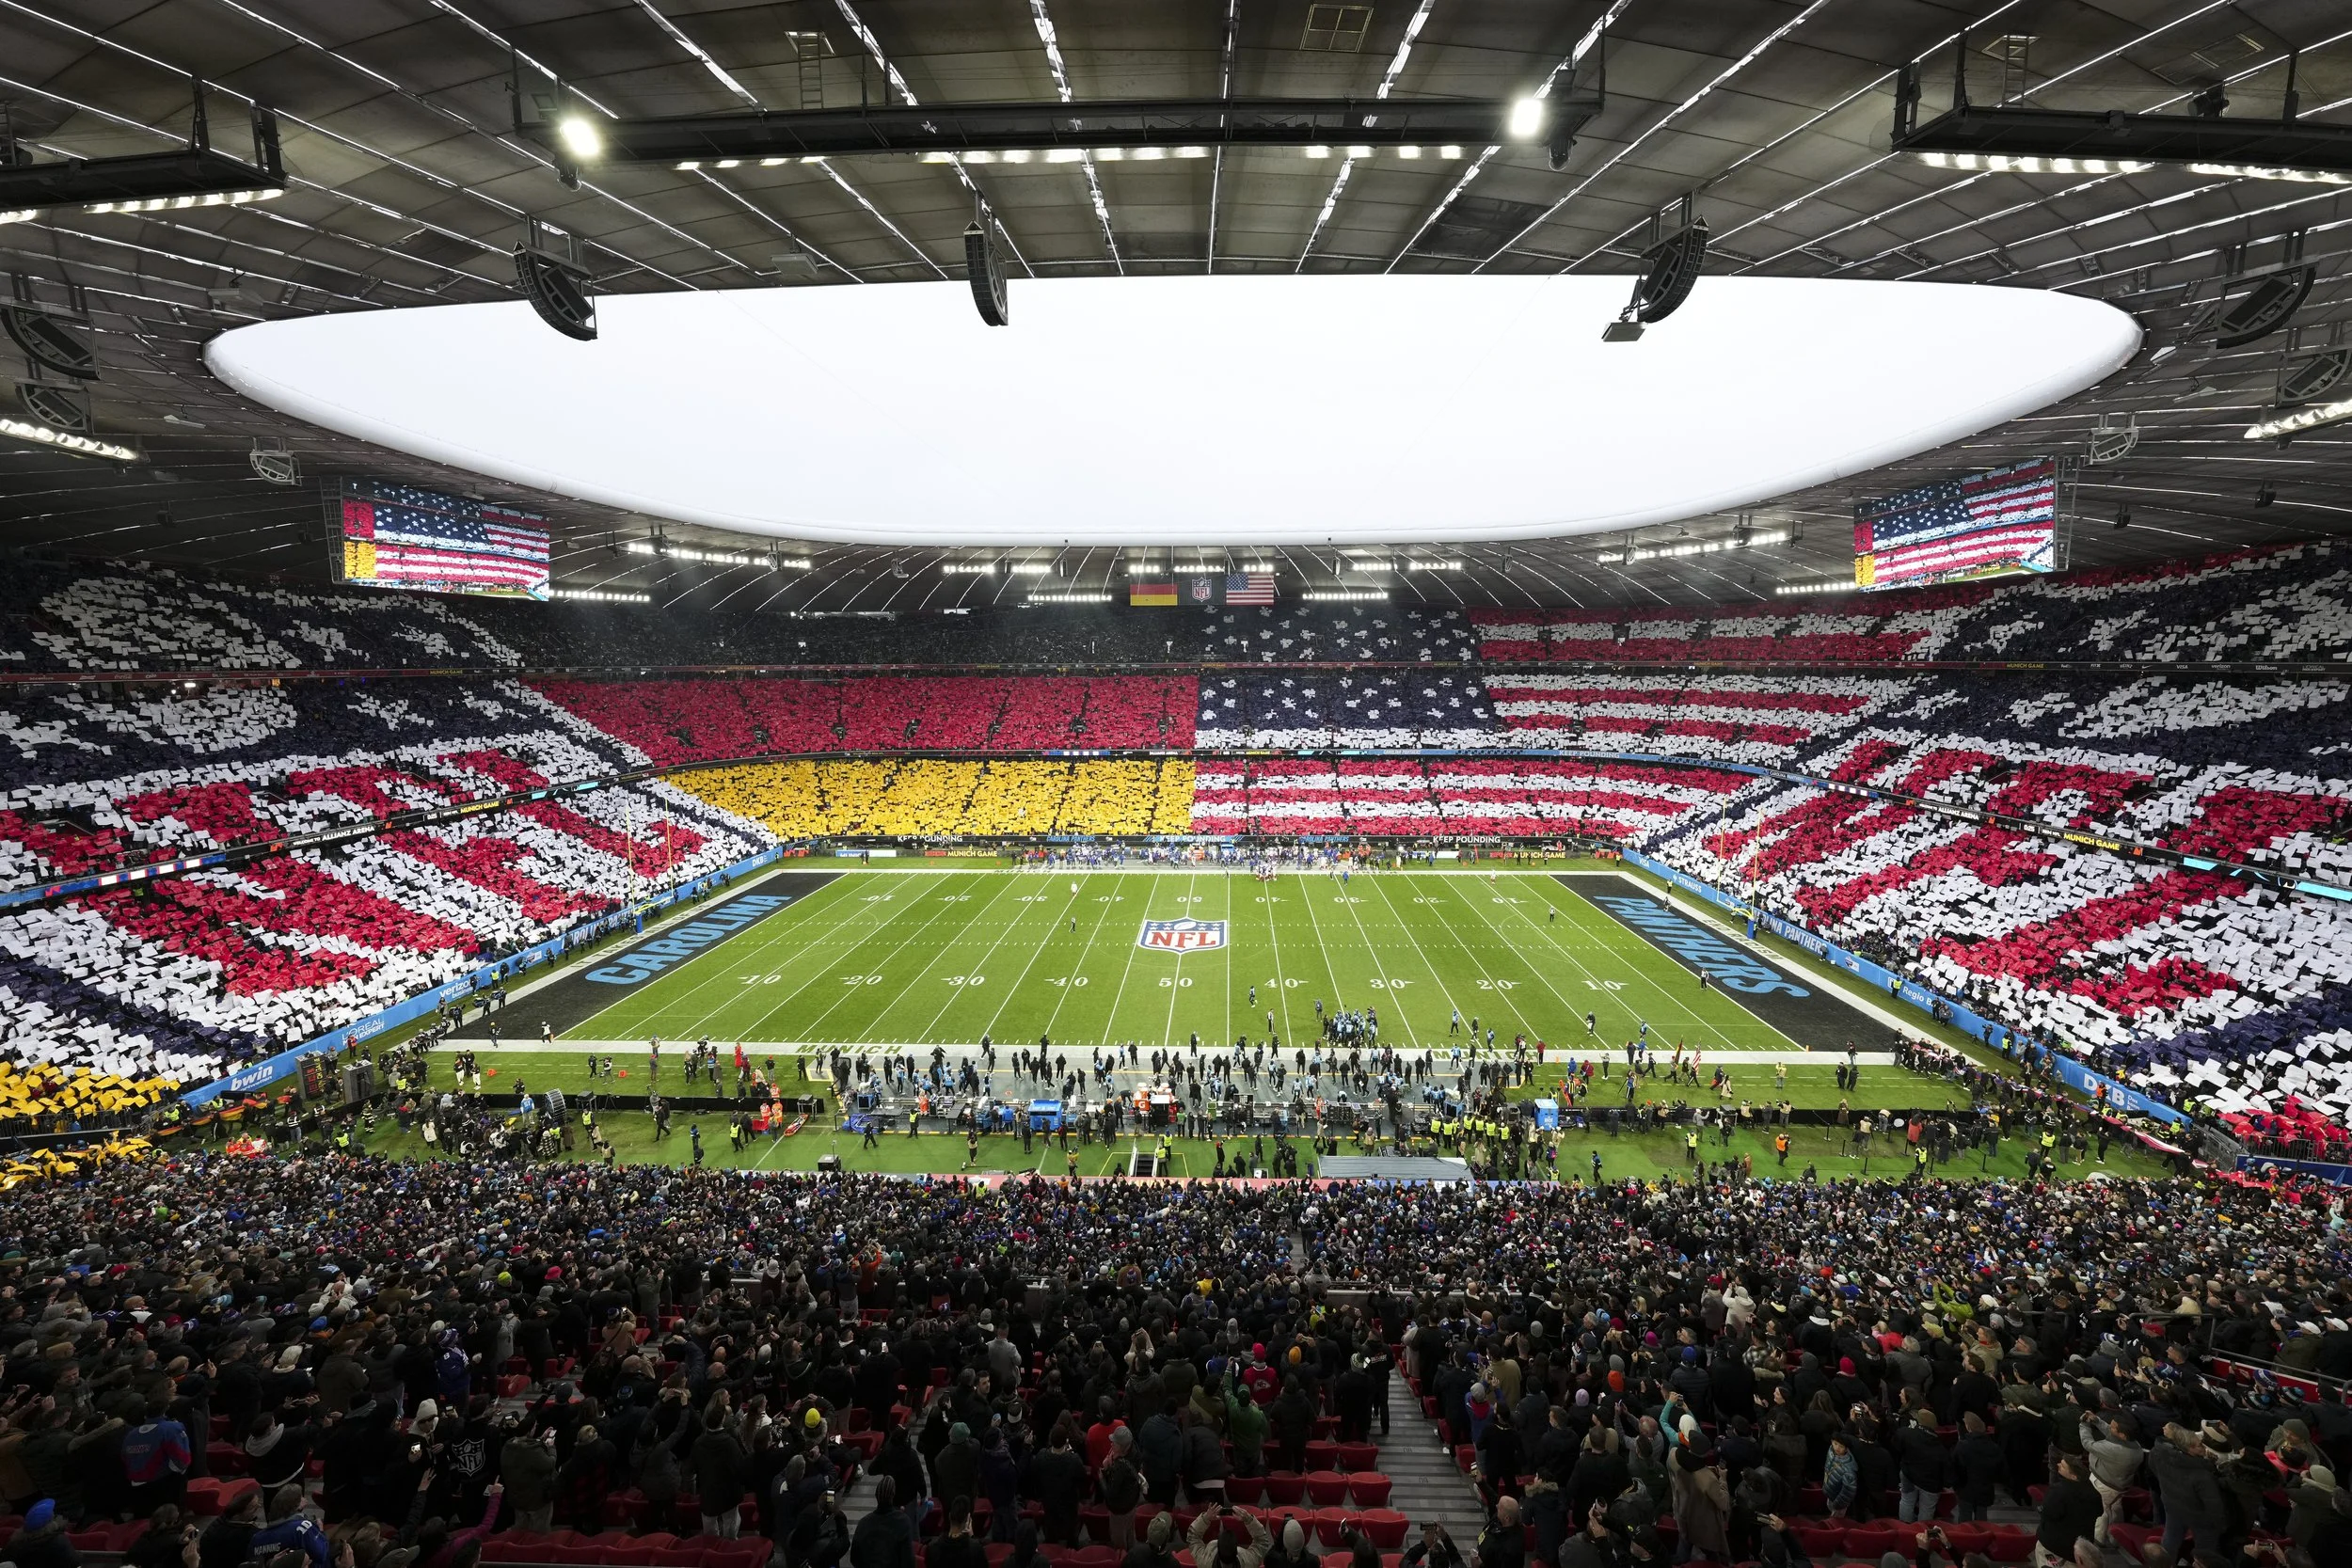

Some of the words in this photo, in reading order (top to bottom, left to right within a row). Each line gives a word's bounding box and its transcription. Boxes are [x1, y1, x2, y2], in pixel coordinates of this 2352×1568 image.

[1194, 588, 1209, 597] NFL
[460, 804, 483, 814] MUNICH
[484, 800, 500, 809] GAME
[1938, 806, 1960, 816] ALLIANZ
[1961, 811, 1979, 820] ARENA
[322, 831, 352, 841] ALLIANZ
[352, 826, 375, 835] ARENA
[2063, 832, 2095, 846] MUNICH
[2095, 839, 2121, 851] GAME
[752, 855, 764, 867] DKB
[1639, 857, 1650, 868] VISA
[1678, 876, 1702, 894] STRAUSS
[585, 895, 792, 985] CAROLINA
[1151, 931, 1216, 948] NFL
[1727, 932, 1784, 959] RACISM
[1594, 895, 1811, 998] PANTHERS
[744, 974, 781, 985] 10
[845, 974, 882, 985] 20
[948, 975, 985, 986] 30
[1053, 975, 1089, 987] 40
[1158, 976, 1193, 987] 50
[1263, 977, 1298, 988] 40
[1369, 978, 1406, 989] 30
[1475, 979, 1513, 990] 20
[1581, 979, 1619, 990] 10
[439, 978, 472, 997] verizo
[1902, 983, 1924, 1002] Regio
[358, 1022, 385, 1039] EXPERT
[796, 1044, 902, 1054] MUNICH
[1433, 1051, 1540, 1060] MUNICH
[230, 1066, 273, 1091] bwin
[457, 1451, 485, 1474] NFL
[296, 1520, 312, 1534] 10
[254, 1543, 281, 1556] MANNING
